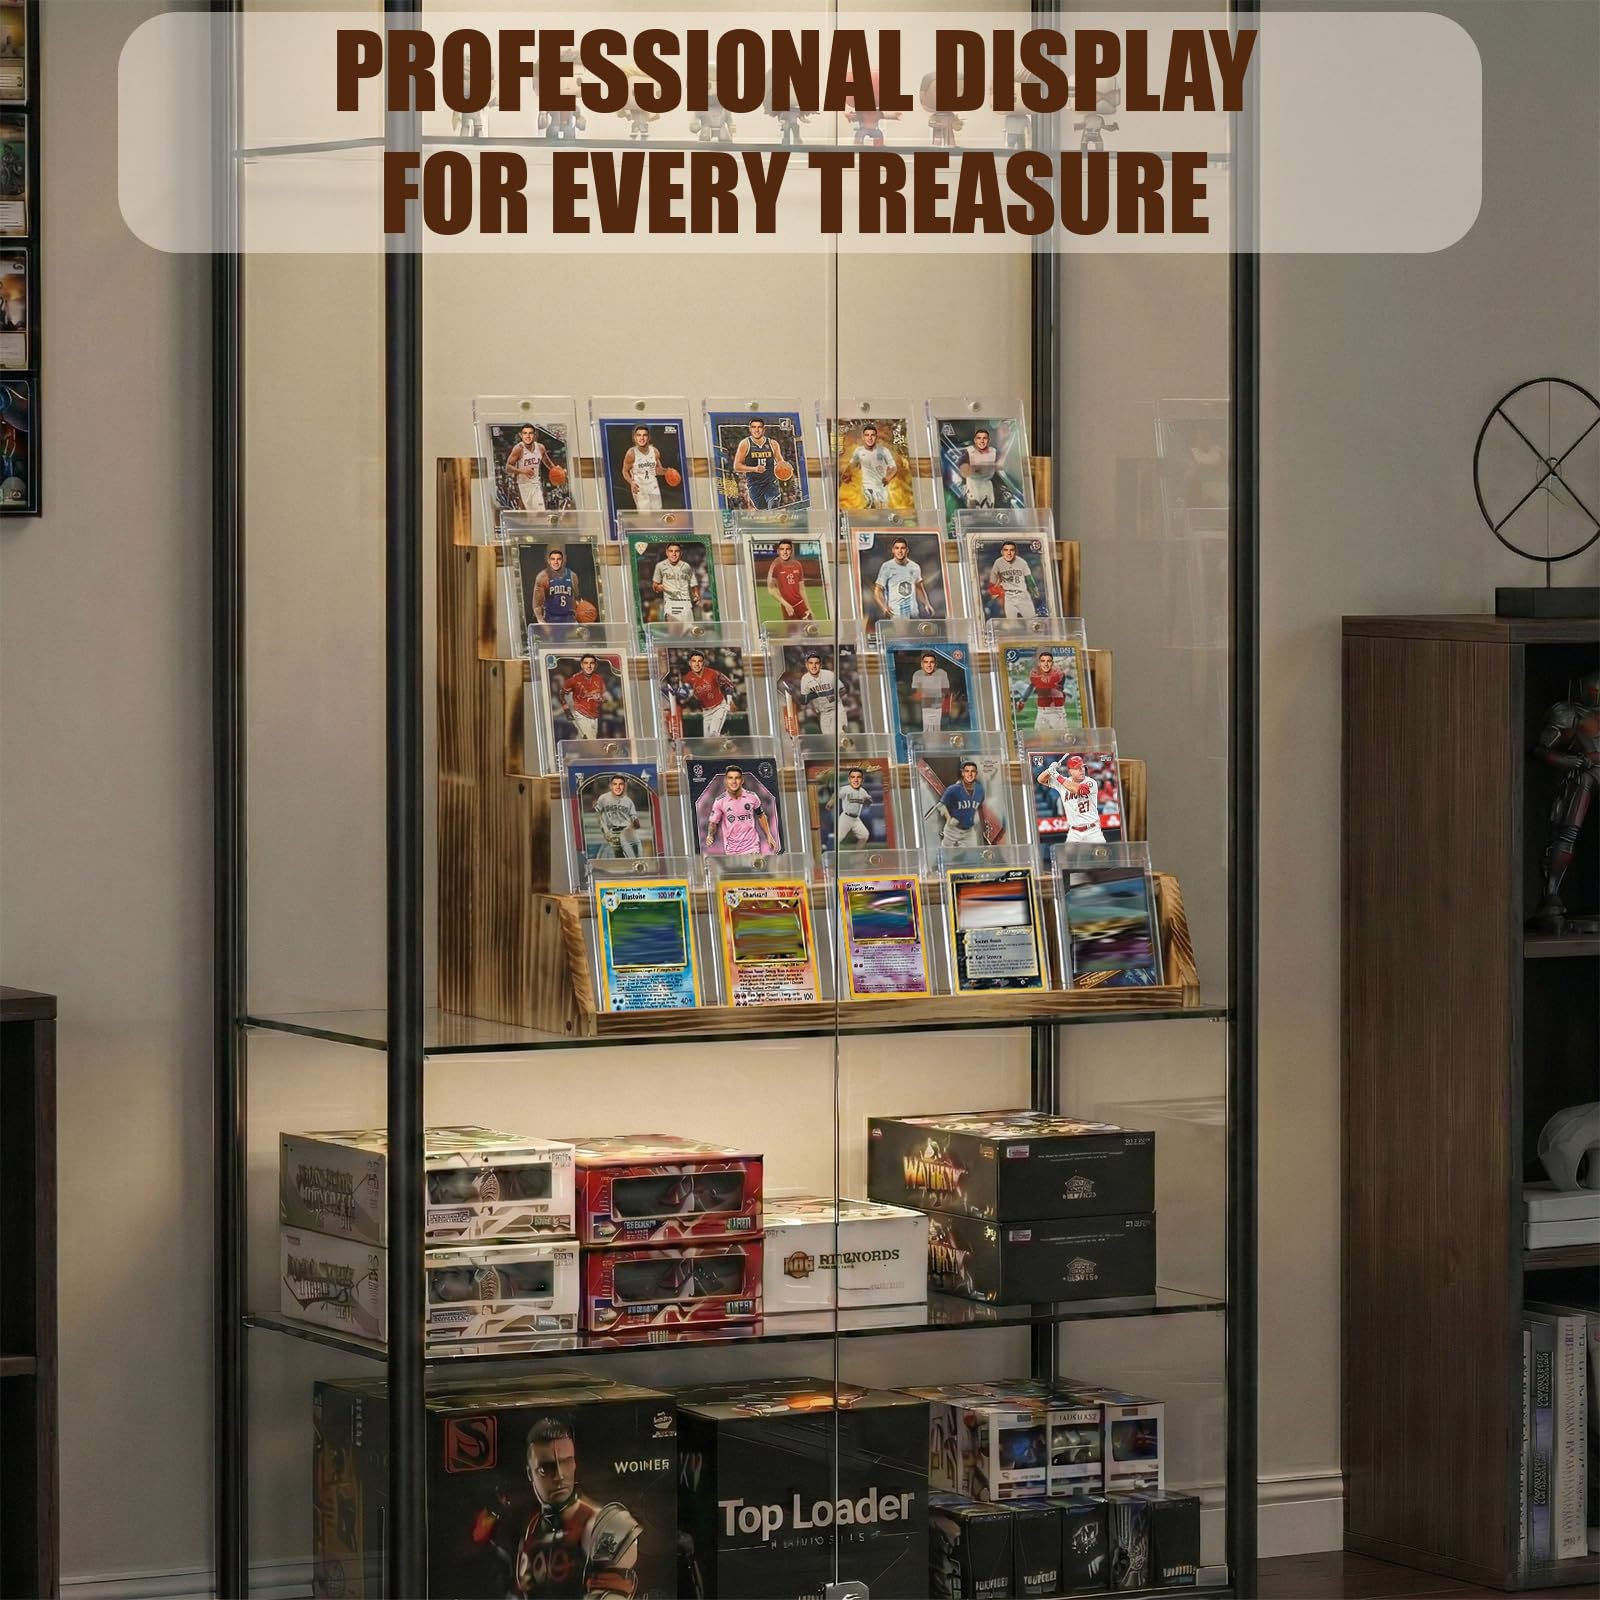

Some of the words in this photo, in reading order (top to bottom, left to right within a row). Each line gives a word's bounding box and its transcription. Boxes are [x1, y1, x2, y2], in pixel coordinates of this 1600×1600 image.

[1077, 800, 1090, 813] 27
[718, 1498, 784, 1542] Top
[793, 1487, 915, 1530] Loader
